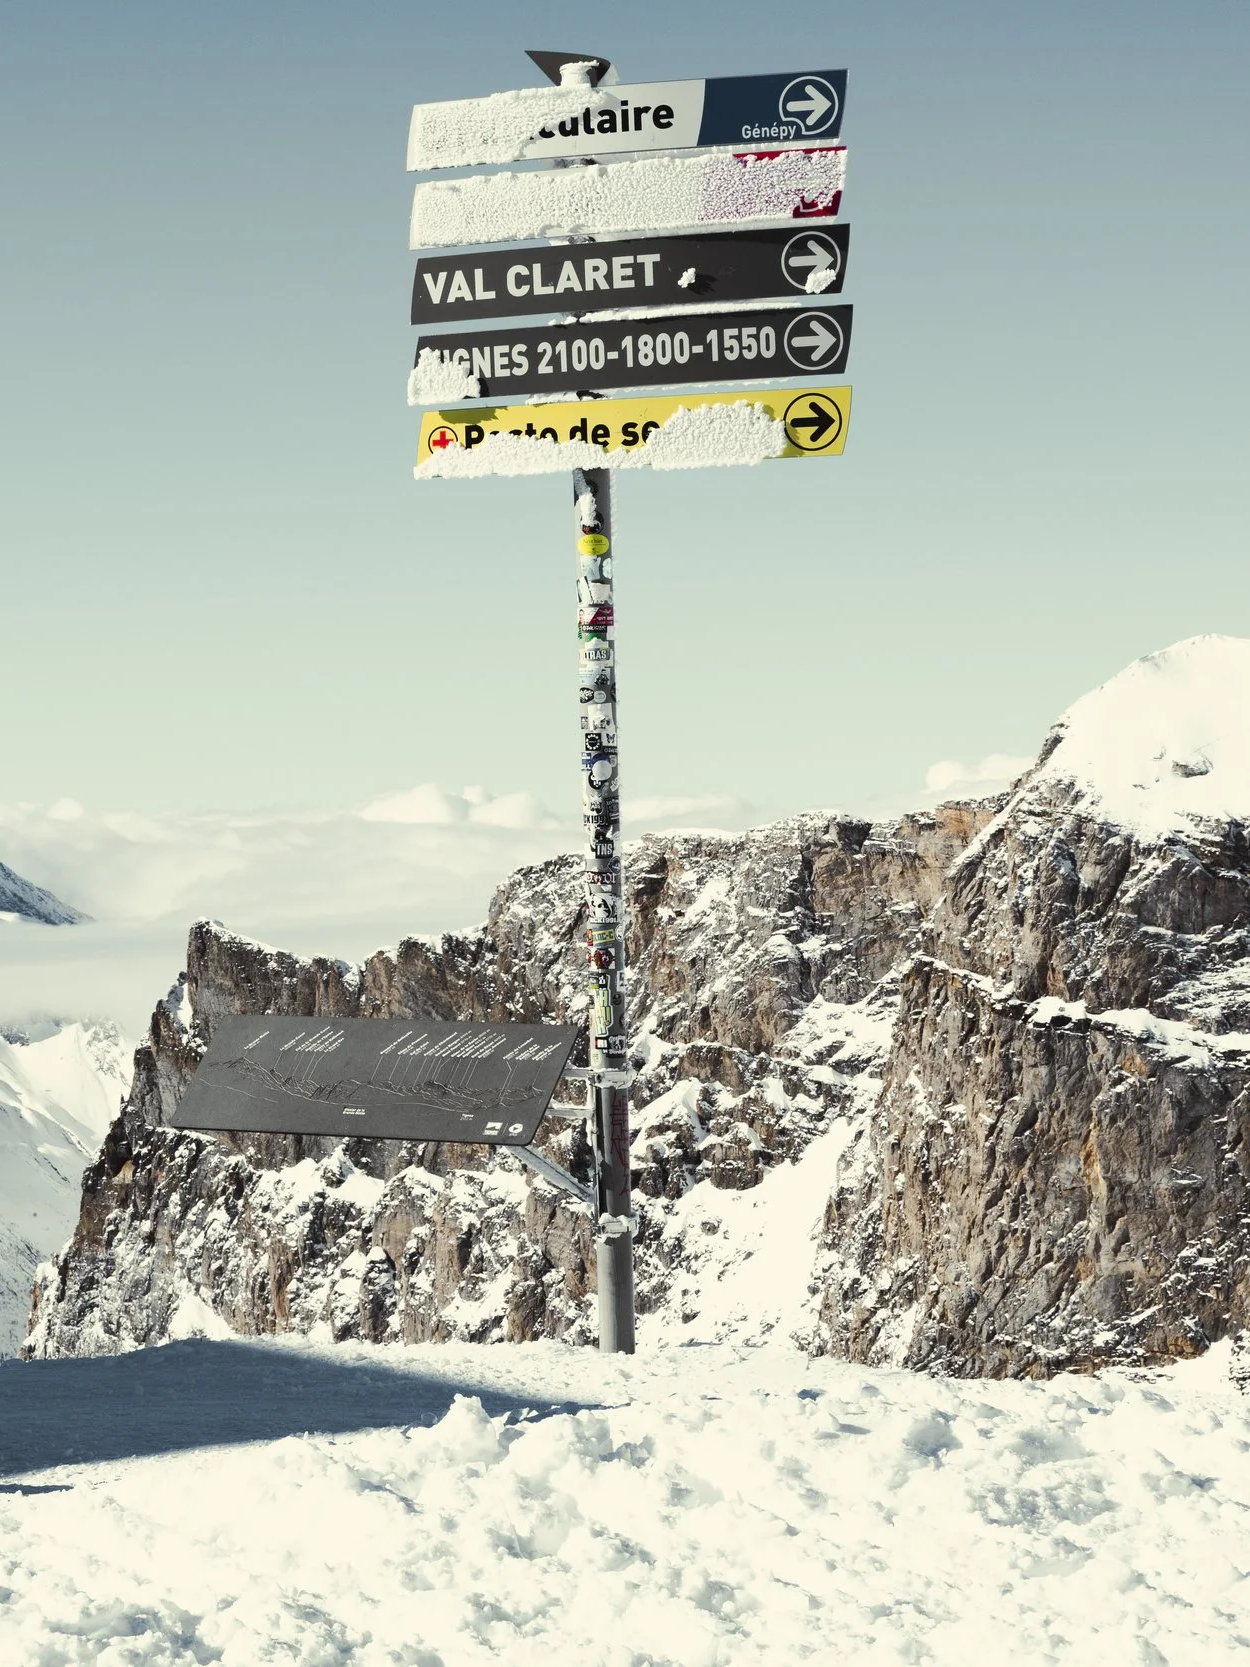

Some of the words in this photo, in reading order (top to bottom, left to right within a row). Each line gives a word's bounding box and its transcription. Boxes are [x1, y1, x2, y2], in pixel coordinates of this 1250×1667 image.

[741, 122, 797, 139] Génépy
[423, 268, 496, 305] VAL
[506, 253, 661, 298] CLARET
[536, 325, 777, 375] 2100-1800-1550
[569, 417, 610, 448] de
